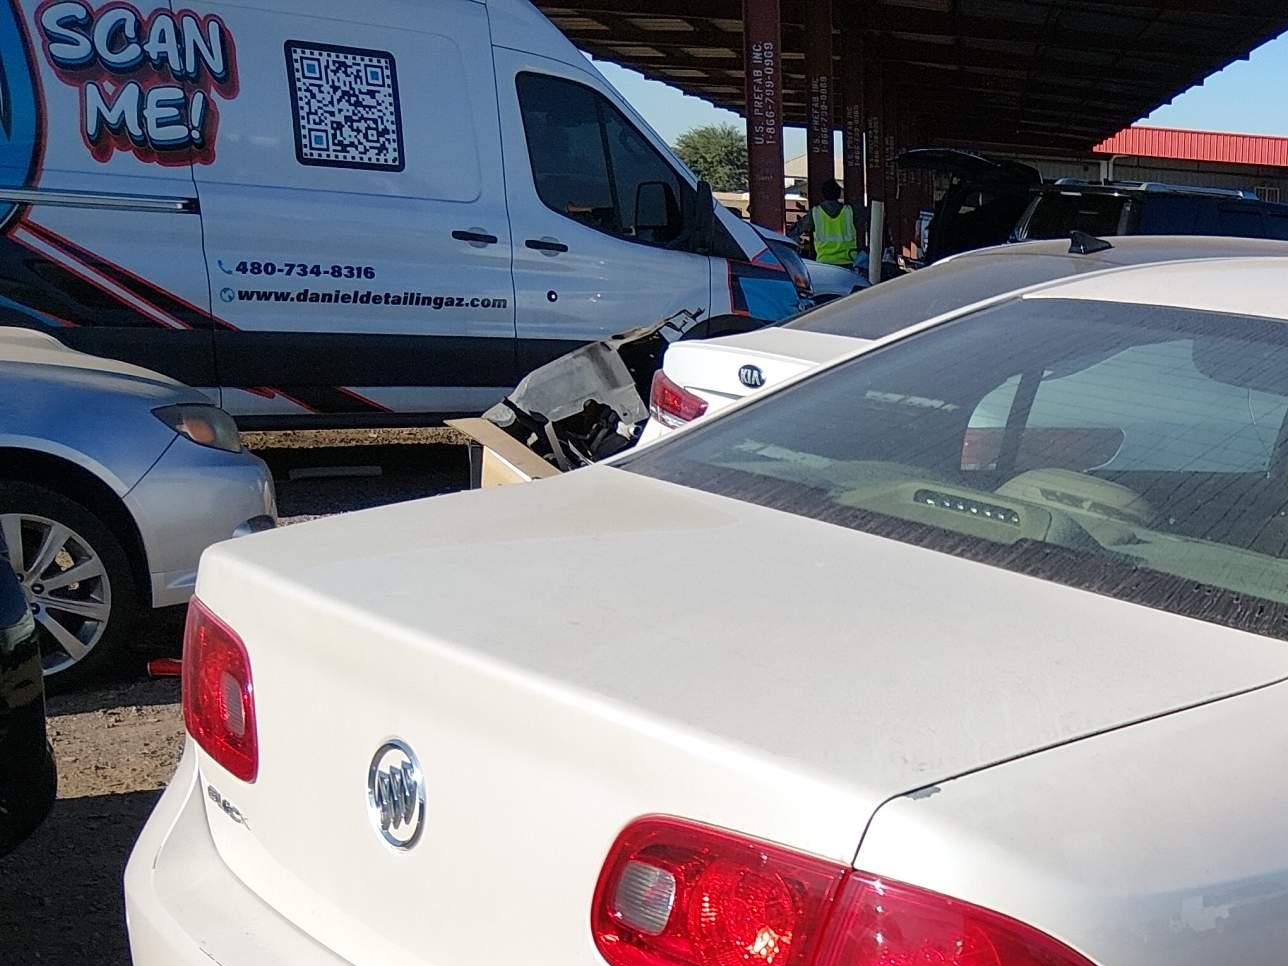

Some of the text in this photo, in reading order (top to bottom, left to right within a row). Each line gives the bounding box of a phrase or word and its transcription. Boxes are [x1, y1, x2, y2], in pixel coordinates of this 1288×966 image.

[40, 2, 229, 83] SCAN
[752, 69, 763, 116] PREFAB
[85, 81, 206, 150] ME!
[235, 261, 376, 280] 480-734-8316
[238, 288, 508, 310] www.danieldetailingaz.com
[740, 367, 761, 386] KIA
